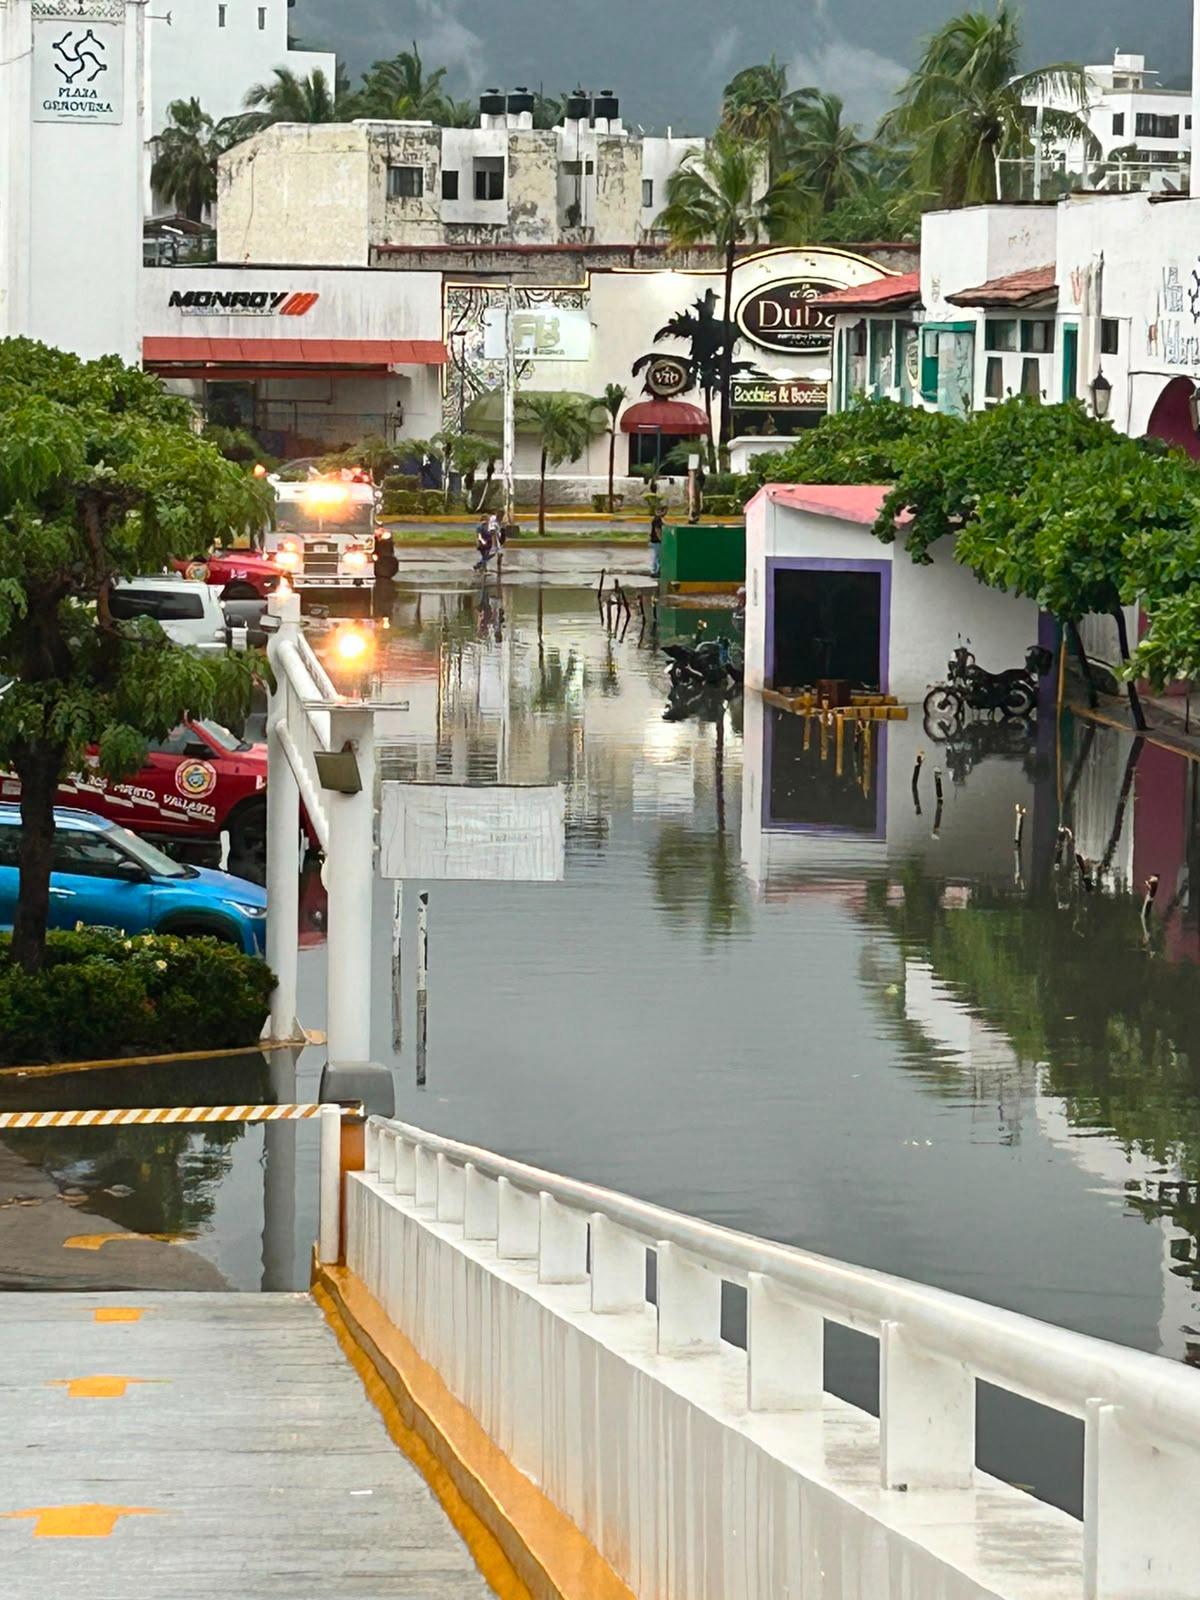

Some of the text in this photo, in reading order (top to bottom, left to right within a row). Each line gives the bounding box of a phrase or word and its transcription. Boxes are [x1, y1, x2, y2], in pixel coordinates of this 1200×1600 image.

[58, 87, 98, 99] PLAZA
[42, 100, 114, 113] GENOVESA
[168, 290, 290, 308] MONROY
